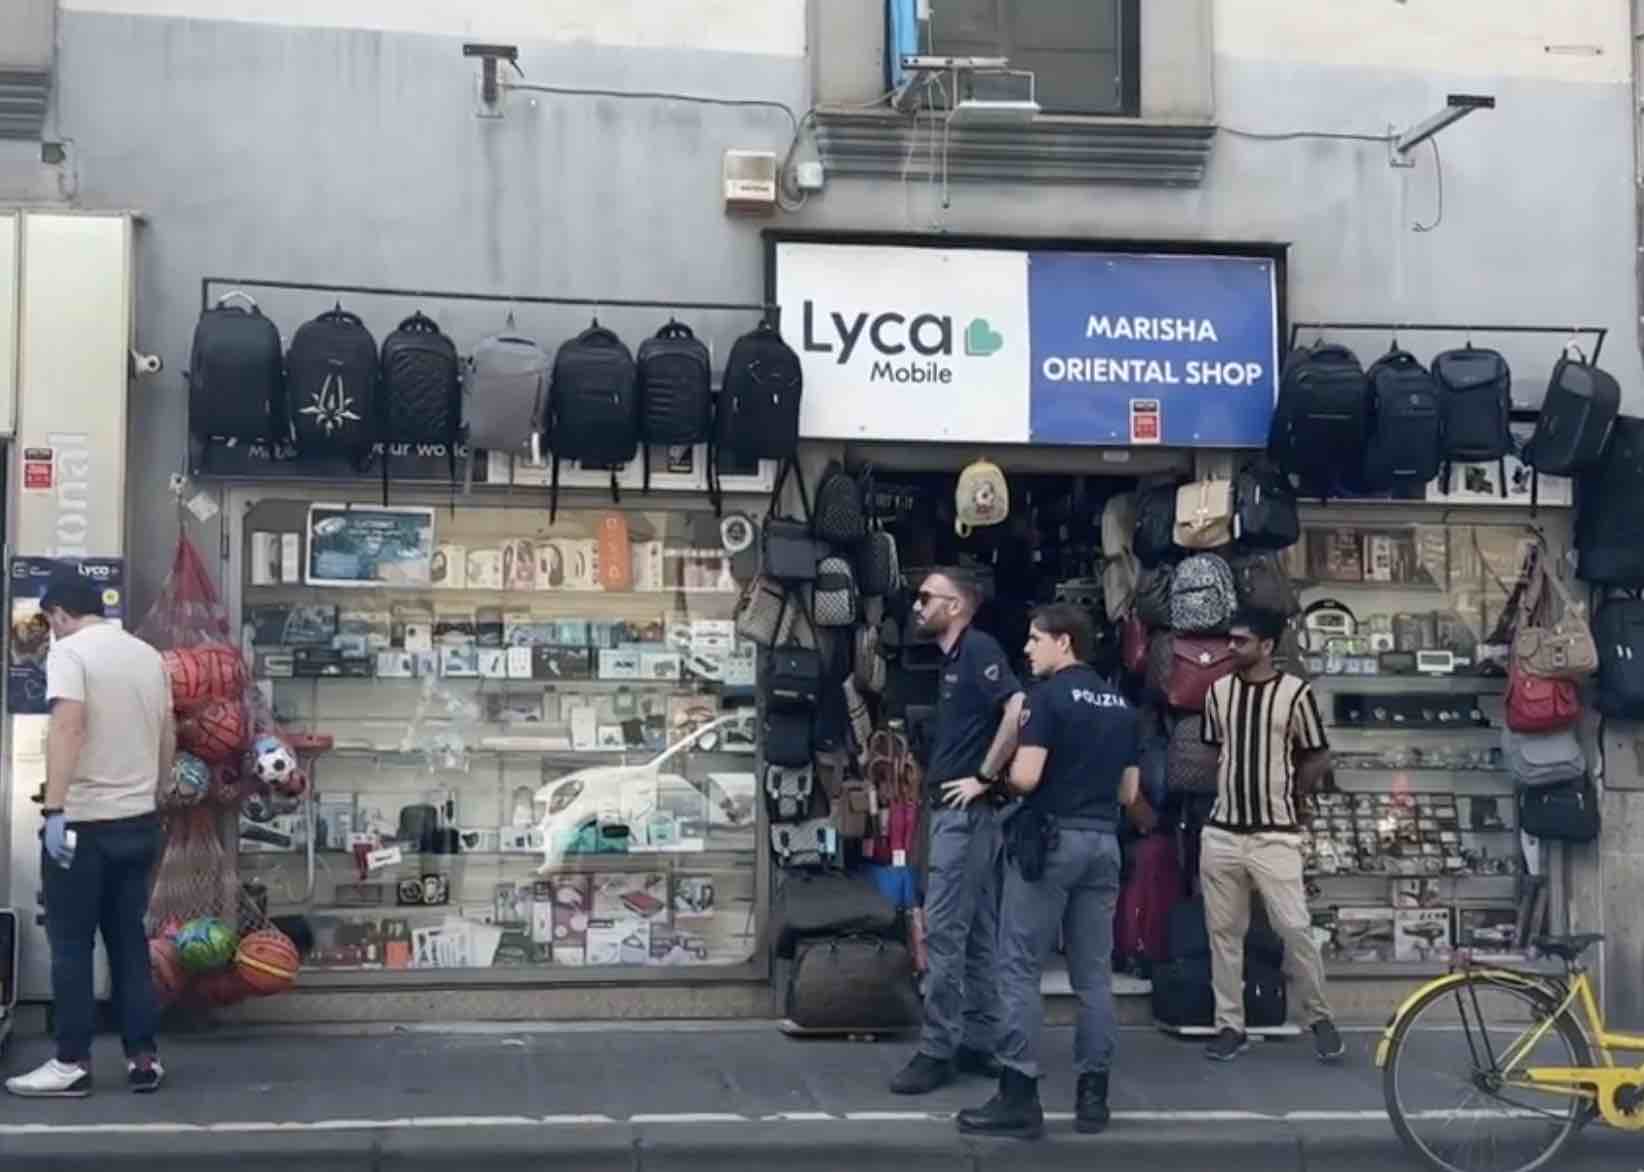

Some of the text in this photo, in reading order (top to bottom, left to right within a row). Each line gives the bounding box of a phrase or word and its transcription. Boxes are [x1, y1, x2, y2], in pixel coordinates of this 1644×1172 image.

[803, 300, 952, 364] Lyca
[1086, 315, 1218, 342] MARISHA
[870, 361, 952, 383] Mobile
[1043, 356, 1262, 385] ORIENTAL SHOP
